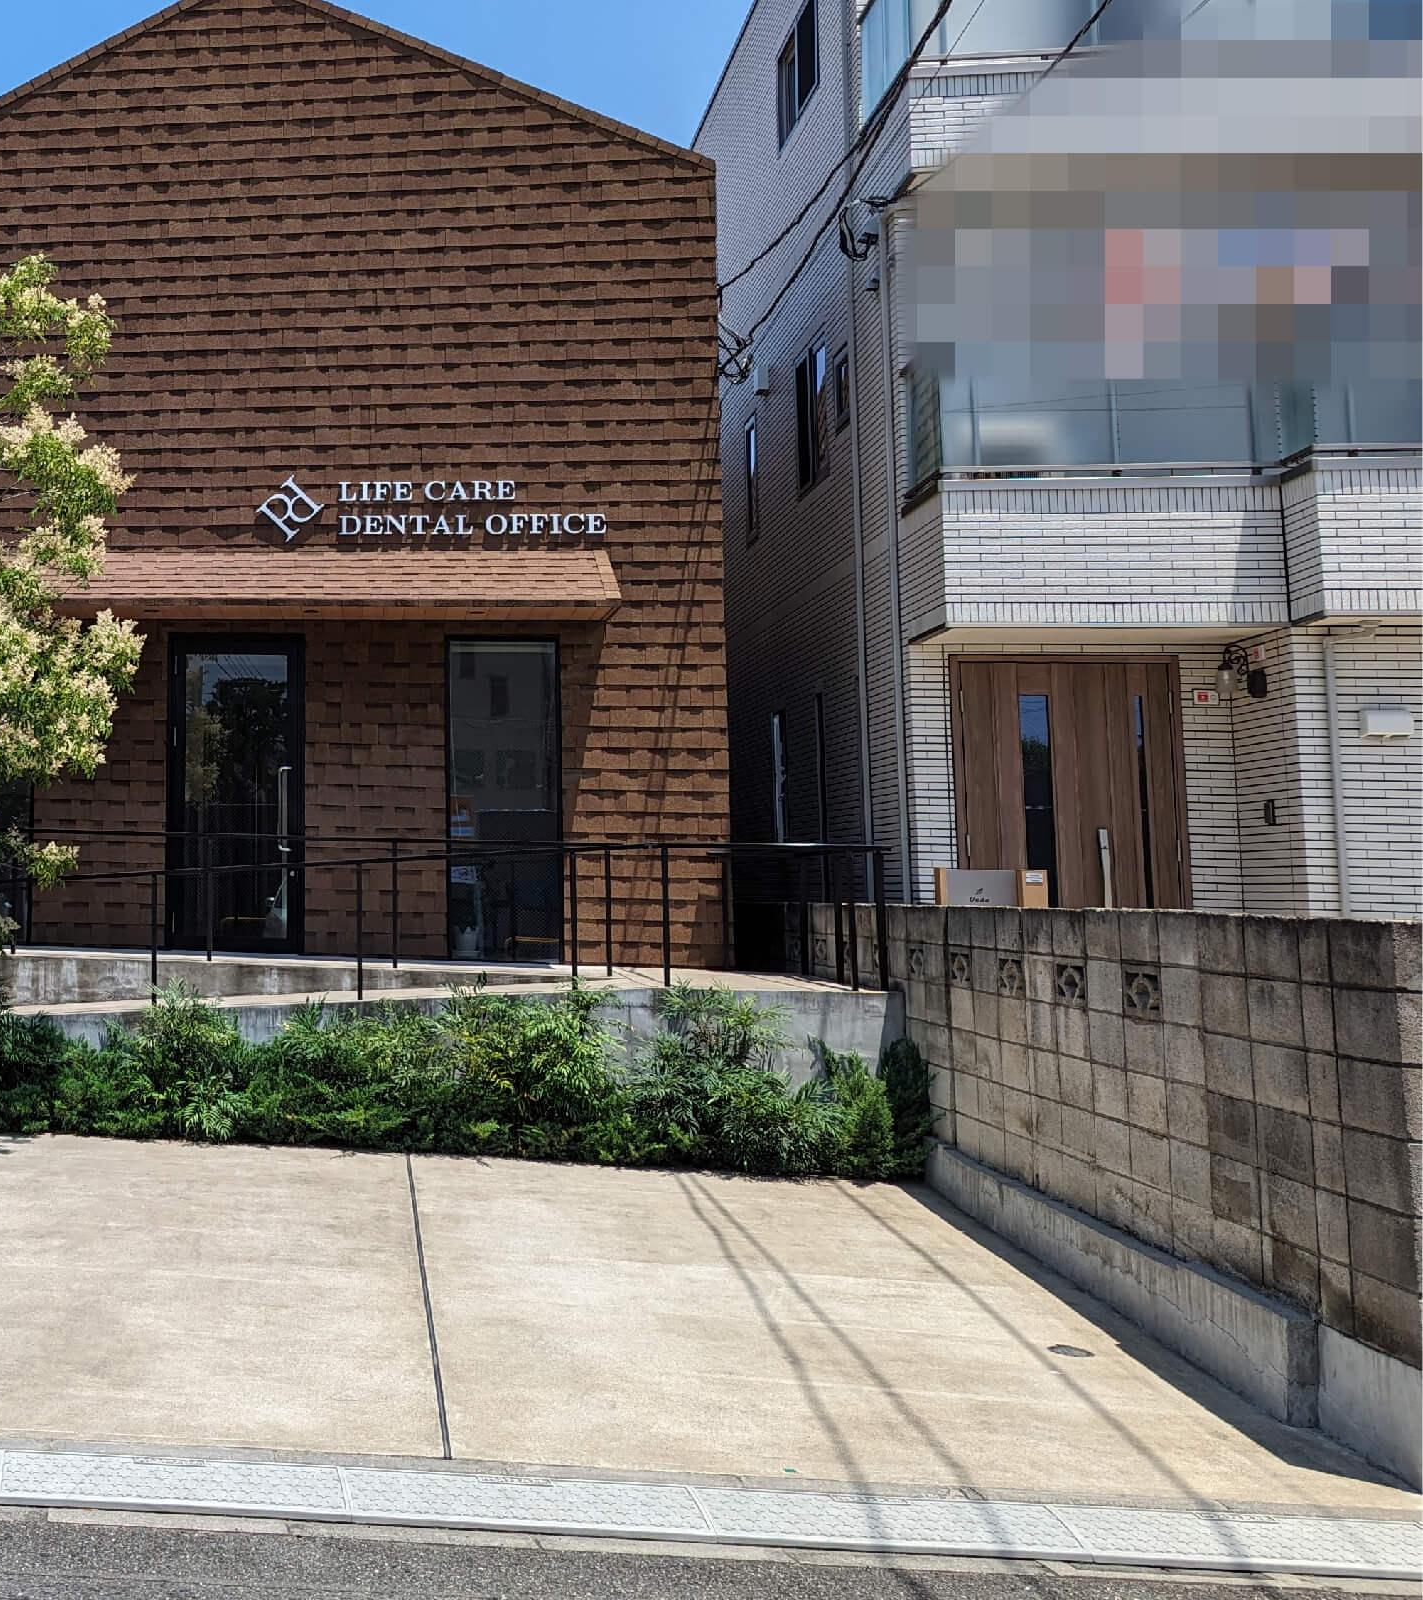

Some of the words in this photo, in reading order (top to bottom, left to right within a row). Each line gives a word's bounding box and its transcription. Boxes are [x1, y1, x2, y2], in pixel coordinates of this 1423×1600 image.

[338, 481, 413, 502] LIFE
[424, 480, 516, 501] CARE
[338, 515, 474, 536] DENTAL
[485, 513, 607, 535] OFFICE
